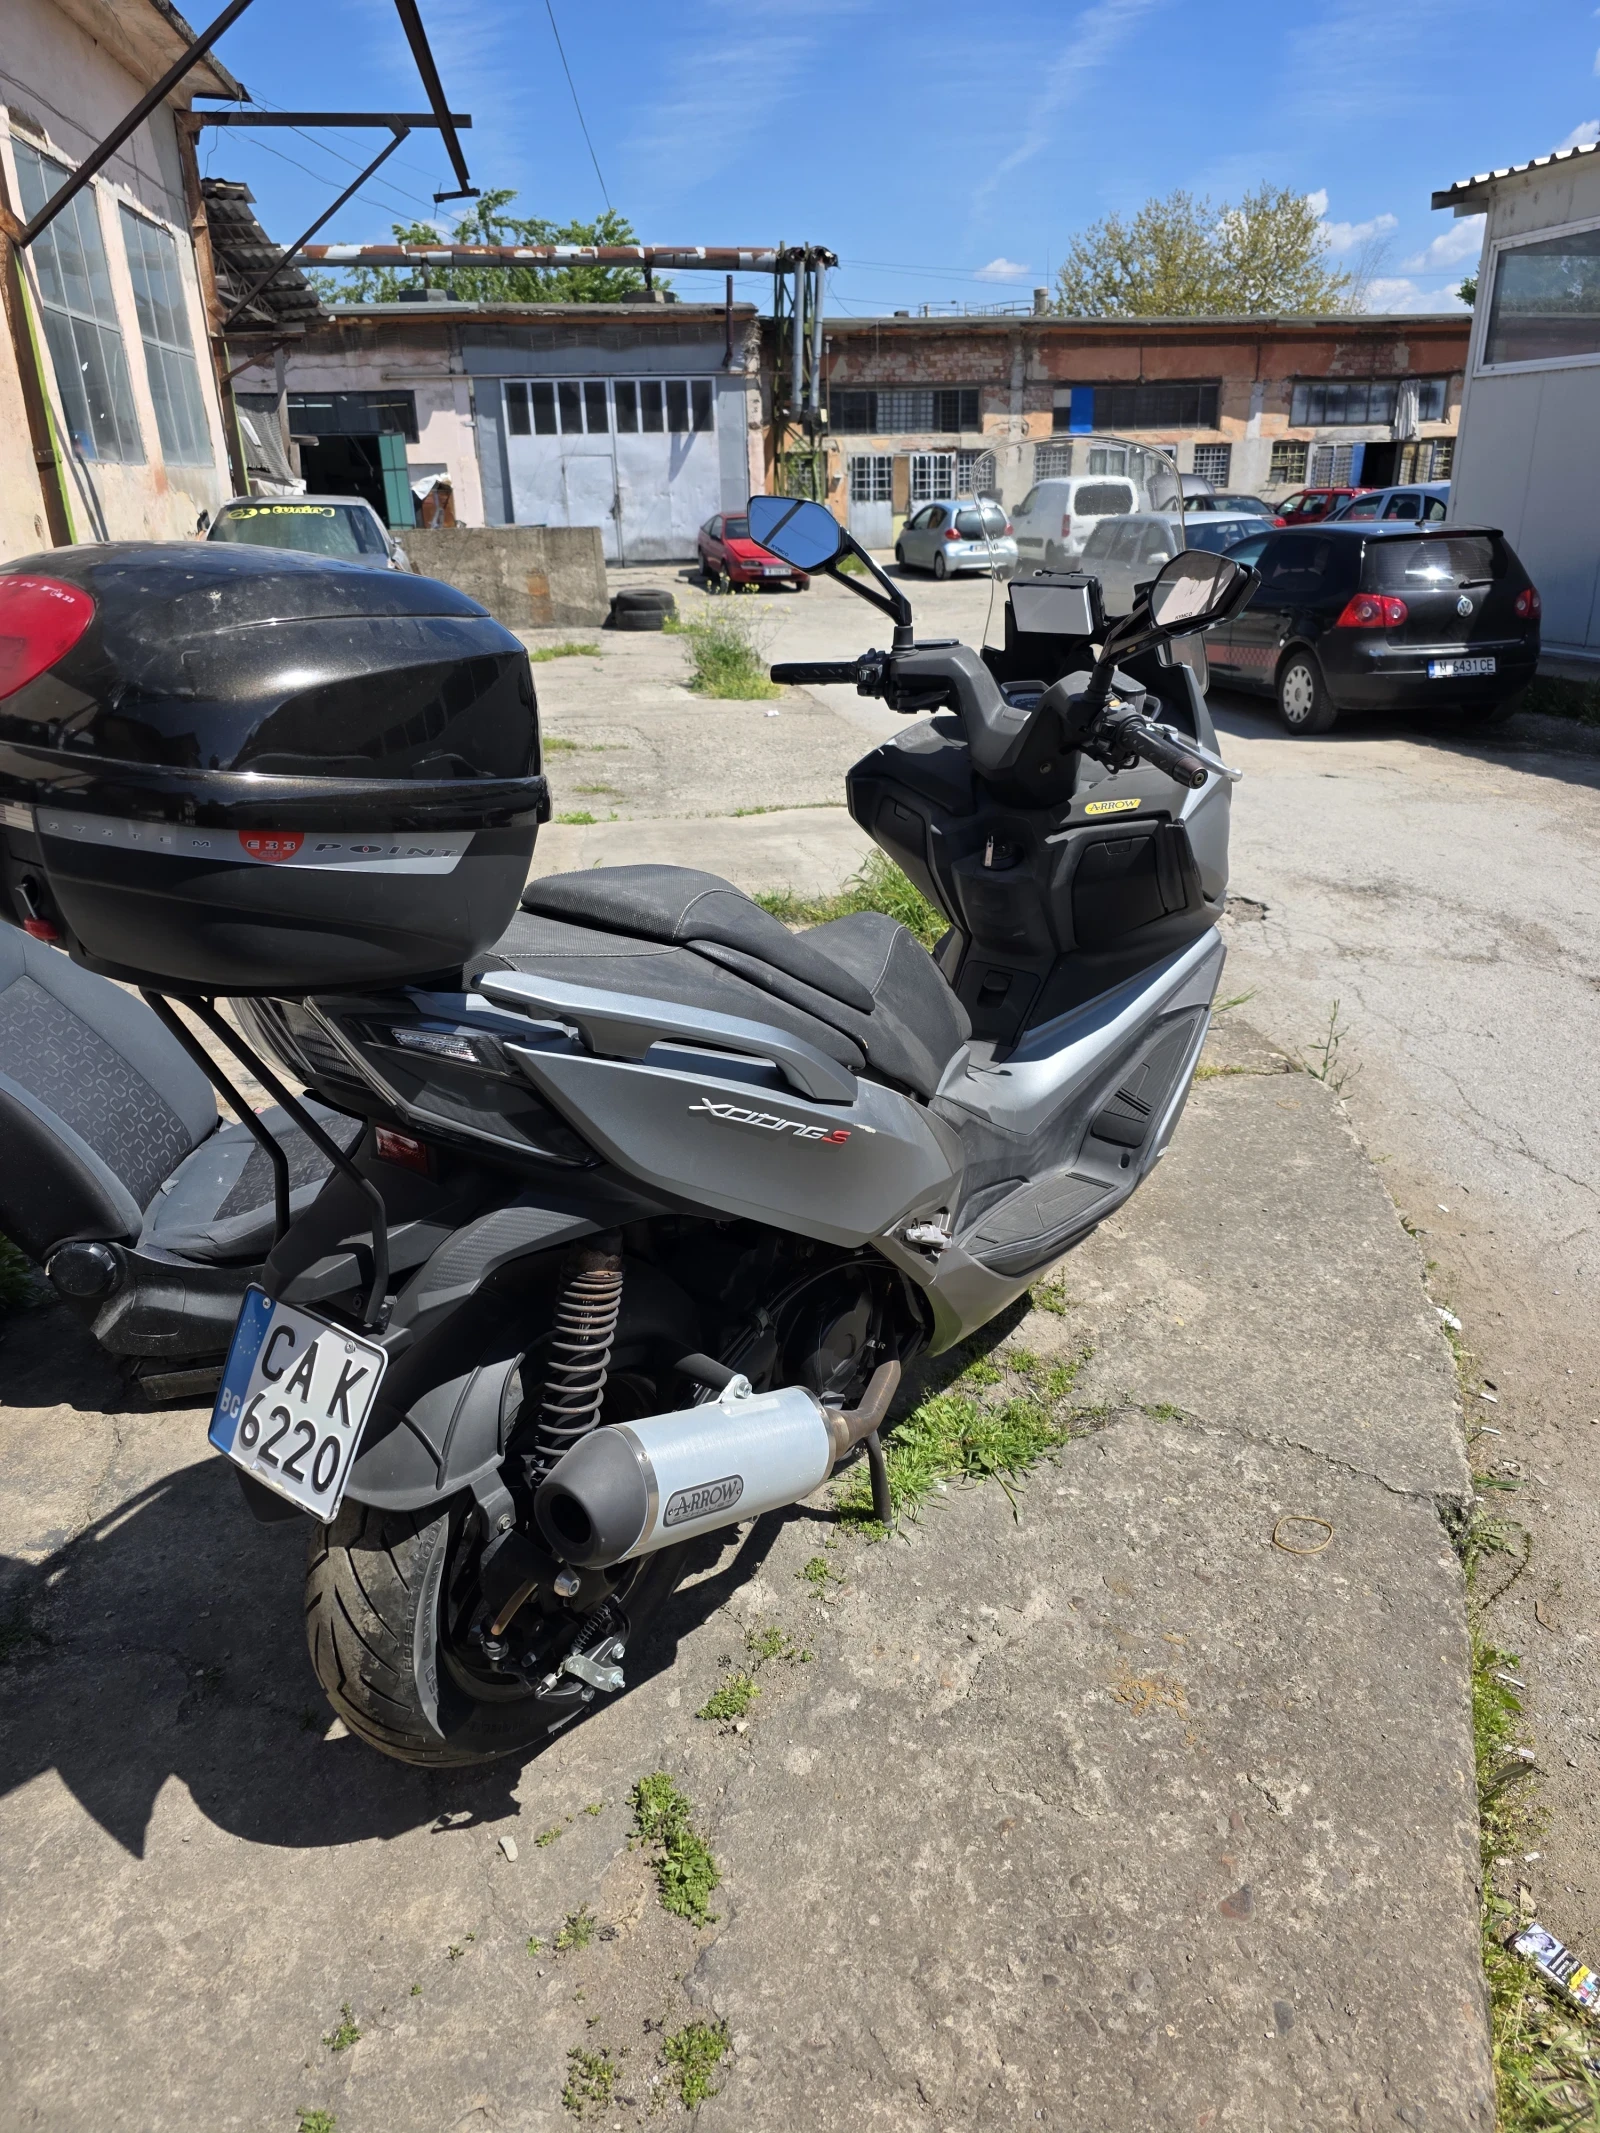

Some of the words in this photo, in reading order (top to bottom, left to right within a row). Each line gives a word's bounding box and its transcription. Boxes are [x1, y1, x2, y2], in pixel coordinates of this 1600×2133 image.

[1174, 611, 1193, 621] KYMCO
[1452, 659, 1478, 673] 6431
[1480, 658, 1494, 671] CE
[1088, 799, 1138, 812] ARROW
[49, 822, 211, 849] SYSTEM
[247, 839, 296, 851] E33
[313, 842, 458, 859] POINT
[219, 1386, 241, 1419] BG
[240, 1392, 342, 1493] 6220
[673, 1480, 739, 1517] ARROW
